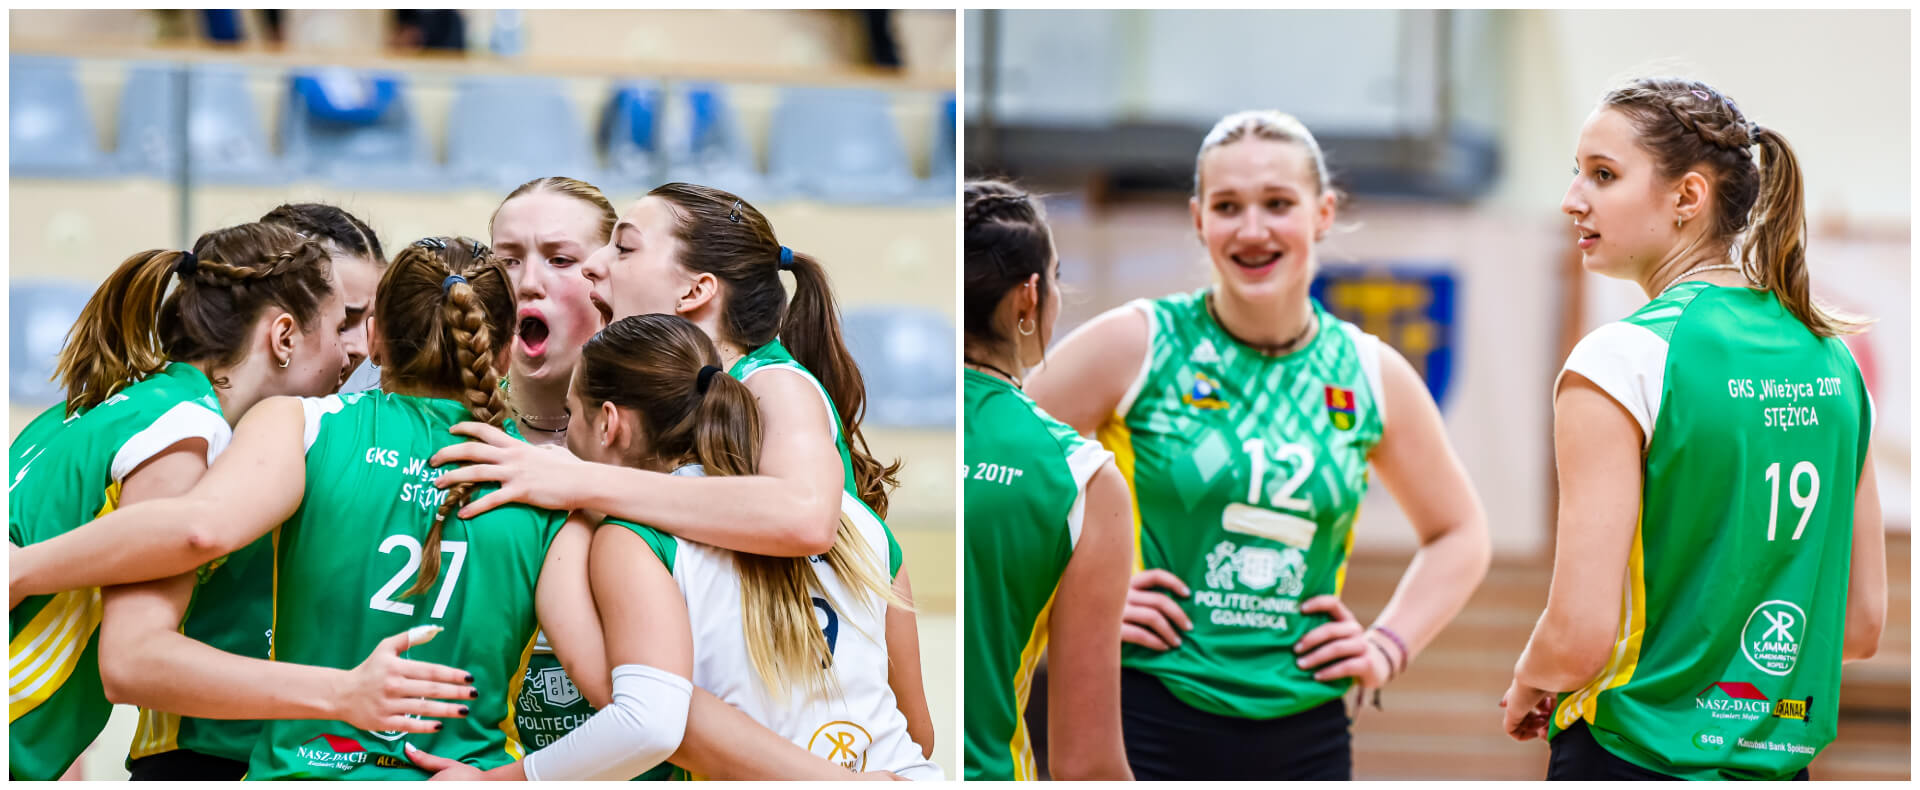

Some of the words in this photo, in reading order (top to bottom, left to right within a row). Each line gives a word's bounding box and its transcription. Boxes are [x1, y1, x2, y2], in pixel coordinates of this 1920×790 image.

[1727, 378, 1755, 398] GKS
[1764, 402, 1819, 432] STĘŻYCA
[365, 447, 399, 468] GKS
[1242, 437, 1316, 512] 12
[1765, 460, 1820, 541] 19
[369, 534, 468, 619] 27
[1696, 697, 1770, 713] NASZ-DACH
[1700, 734, 1724, 745] SGB
